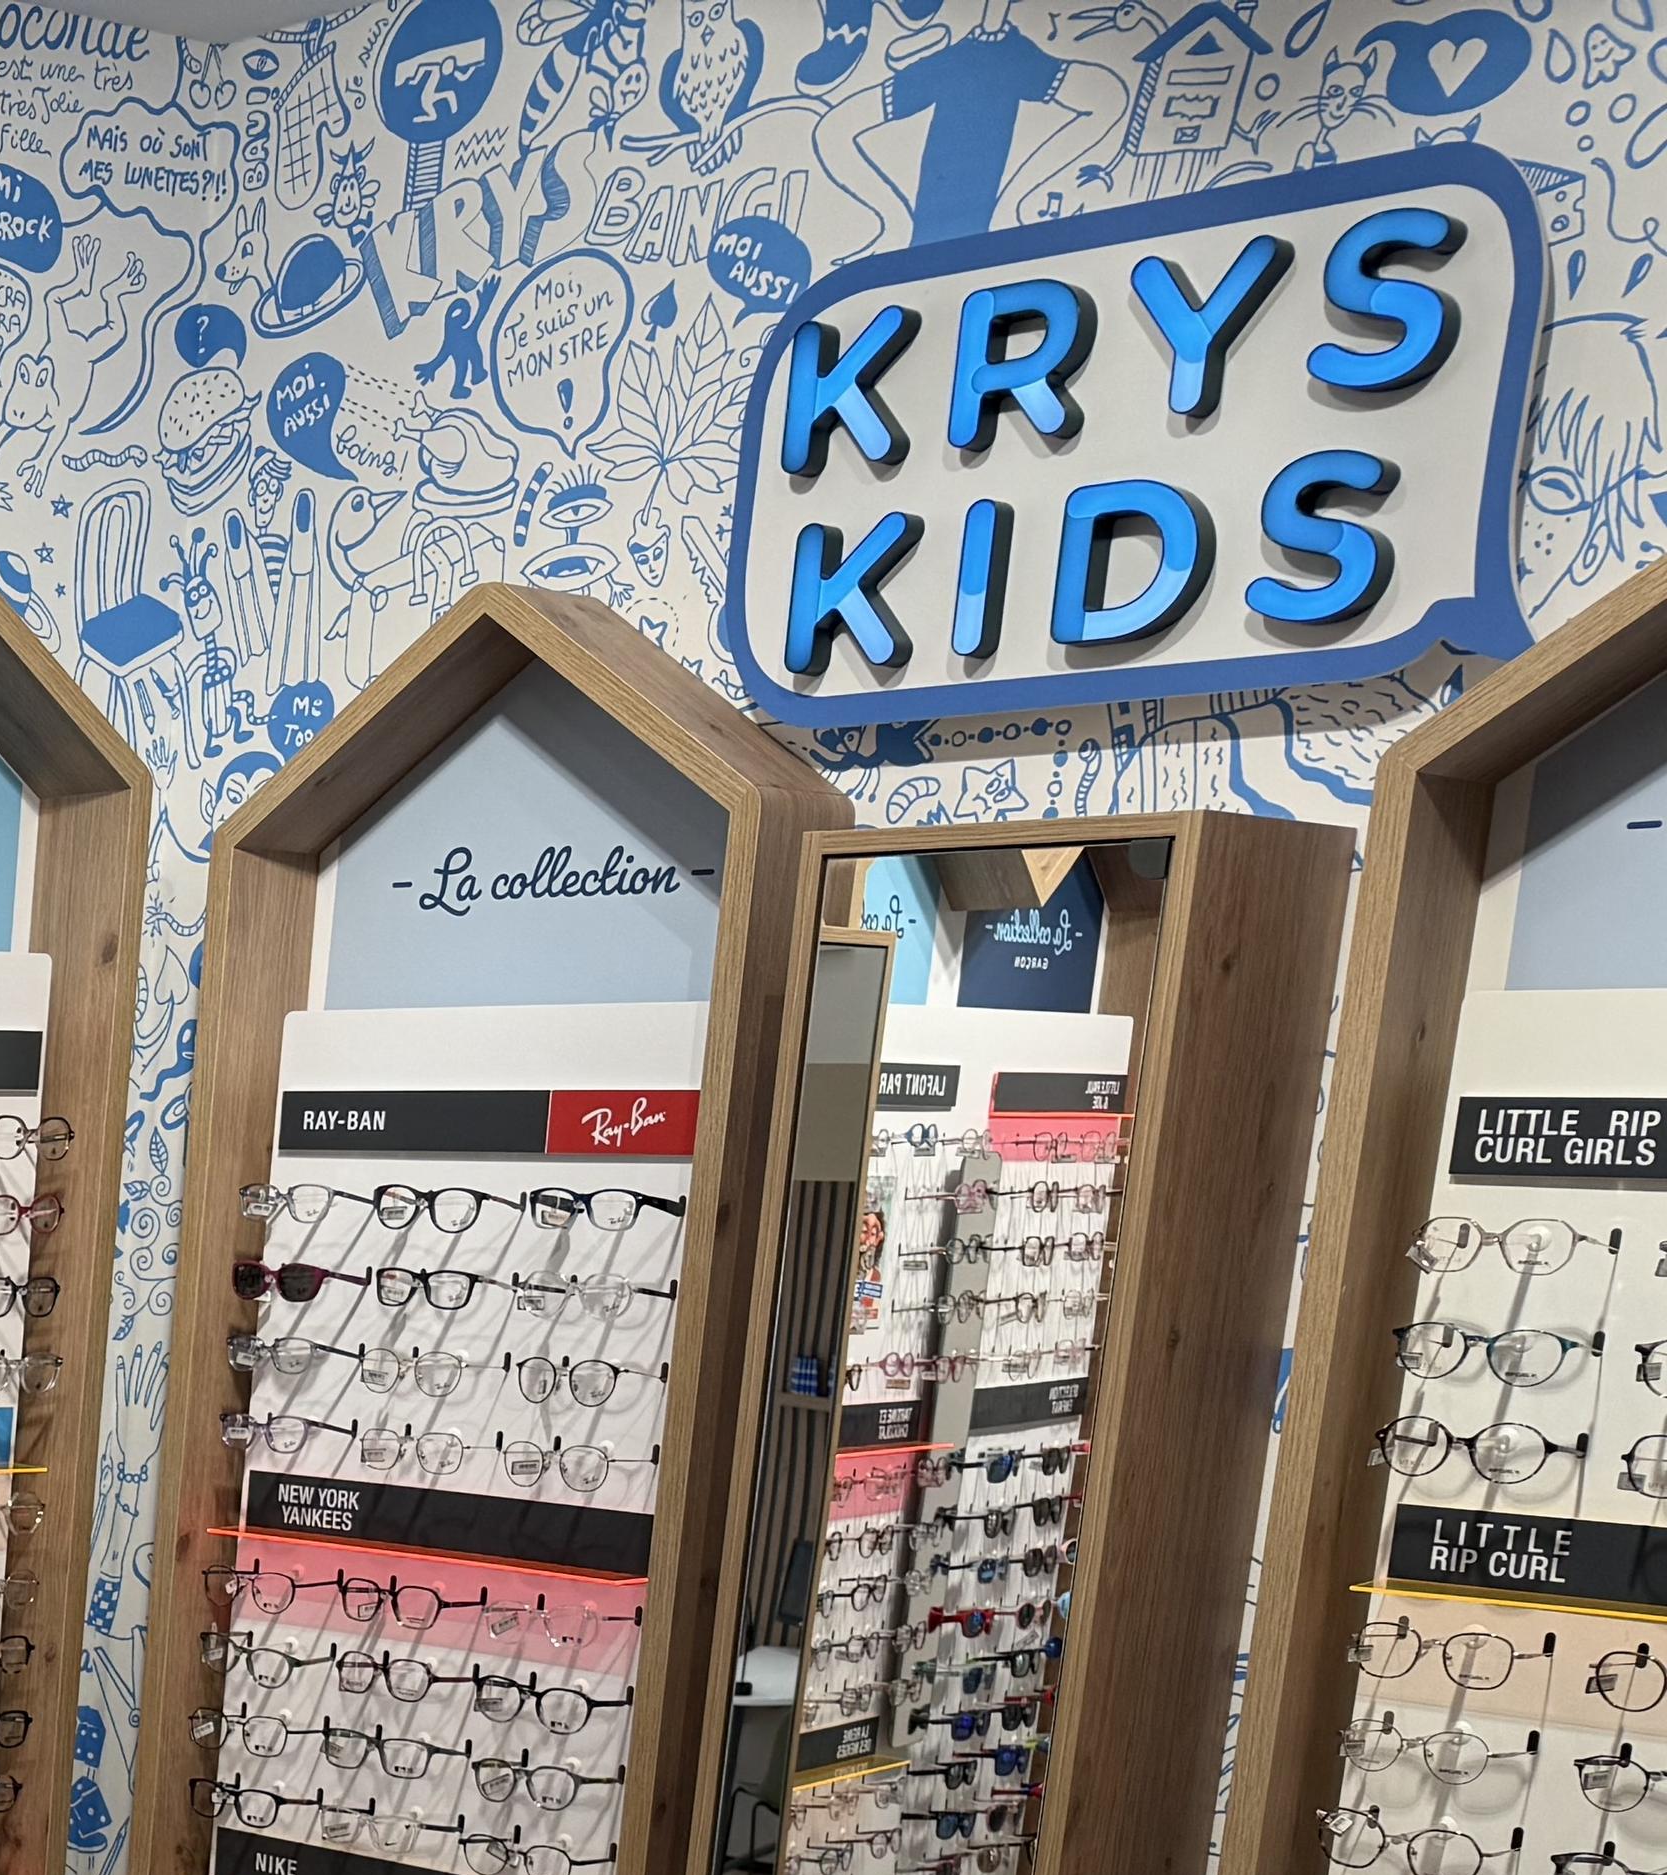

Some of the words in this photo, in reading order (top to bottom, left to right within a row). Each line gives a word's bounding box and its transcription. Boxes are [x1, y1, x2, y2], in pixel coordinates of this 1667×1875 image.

[41, 63, 85, 82] une
[79, 160, 113, 183] MES
[728, 261, 800, 304] AUSSI
[584, 292, 614, 321] un
[781, 207, 1467, 477] KRYS
[285, 393, 330, 438] AUSSI
[784, 449, 1404, 676] KIDS
[419, 847, 482, 916] La
[491, 845, 680, 901] collection
[302, 1110, 386, 1132] RAY-BAN
[581, 1098, 667, 1147] Ray-Ban
[1478, 1109, 1578, 1136] LITTLE
[1608, 1109, 1662, 1137] RIP
[1474, 1137, 1552, 1164] CURL
[1563, 1138, 1656, 1165] GIRLS
[278, 1484, 314, 1509] NEW
[317, 1486, 359, 1511] YORK
[282, 1506, 353, 1531] YANKEES
[1433, 1520, 1572, 1556] LITTLE
[1430, 1548, 1477, 1574] RIP
[1488, 1551, 1566, 1583] CURL
